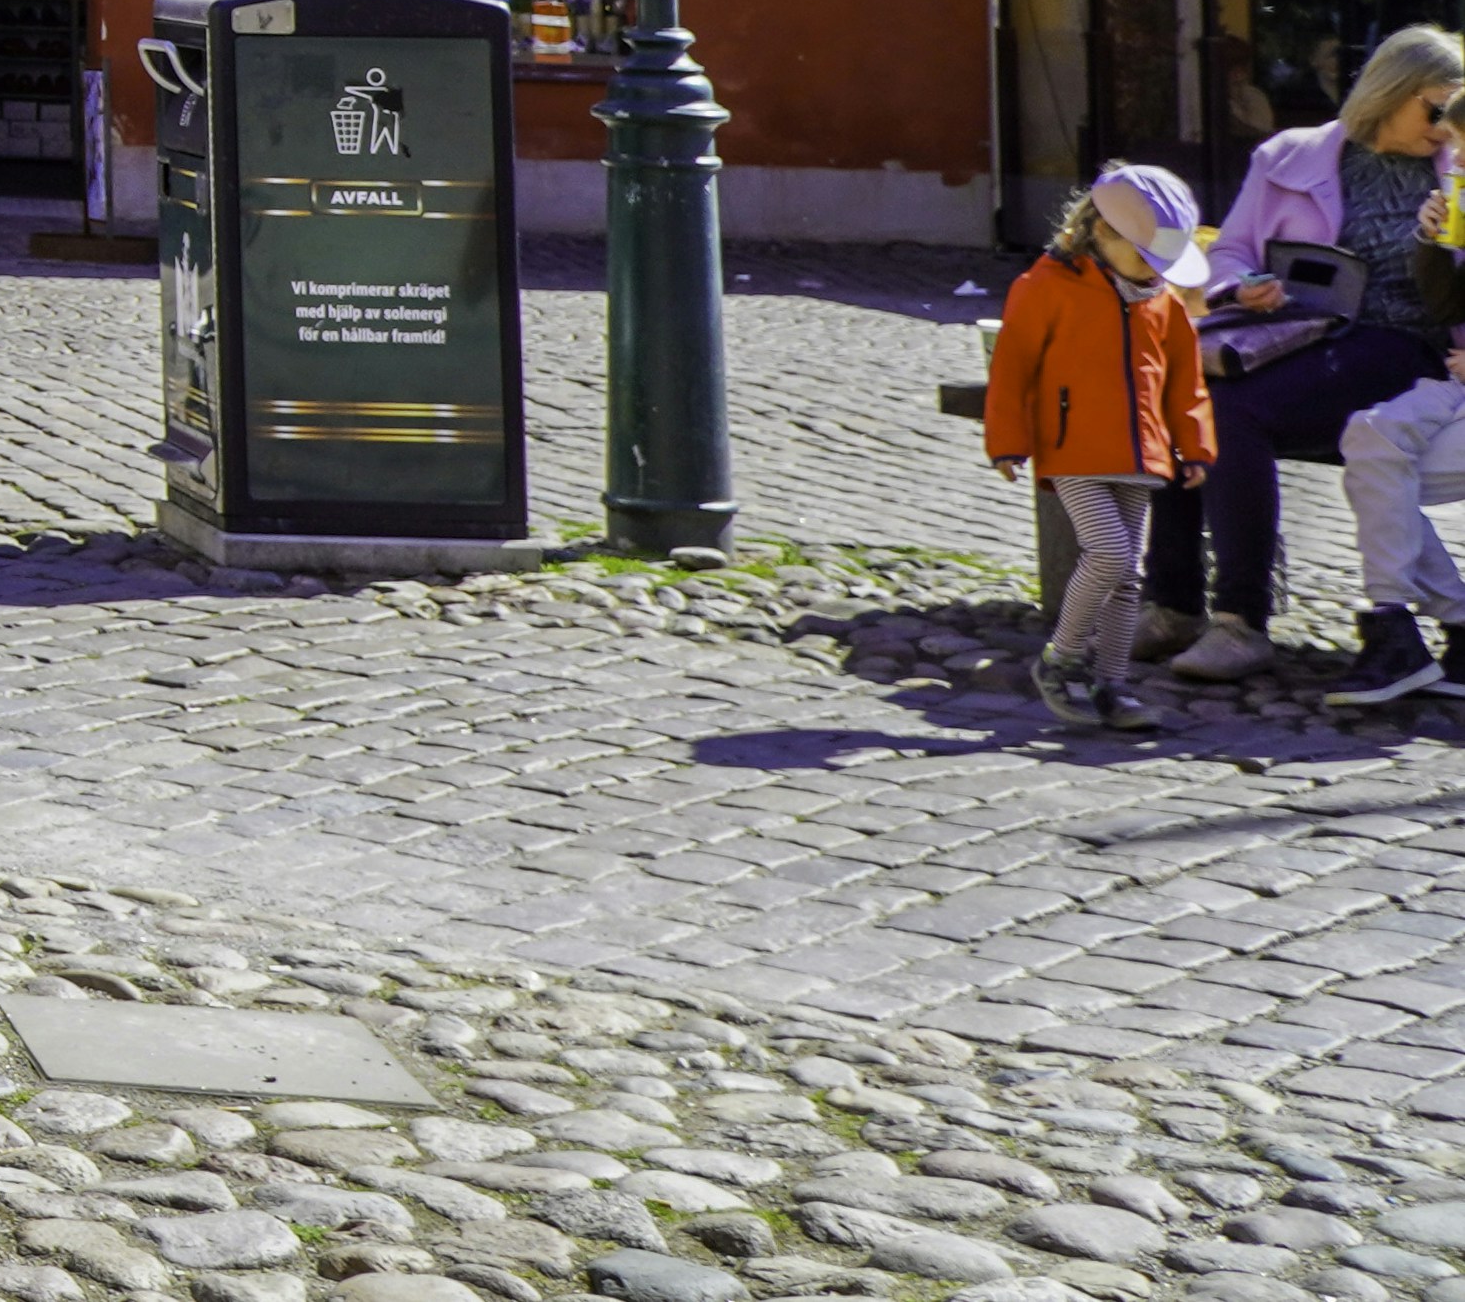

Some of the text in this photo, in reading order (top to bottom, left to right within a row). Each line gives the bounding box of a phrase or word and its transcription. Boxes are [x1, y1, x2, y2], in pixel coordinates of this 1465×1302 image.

[330, 191, 404, 206] AVFALL
[291, 281, 451, 301] Vi komprimerar skräpet
[295, 303, 448, 324] med hjälp av solenergi
[298, 326, 447, 344] för en hållbar framtid!
